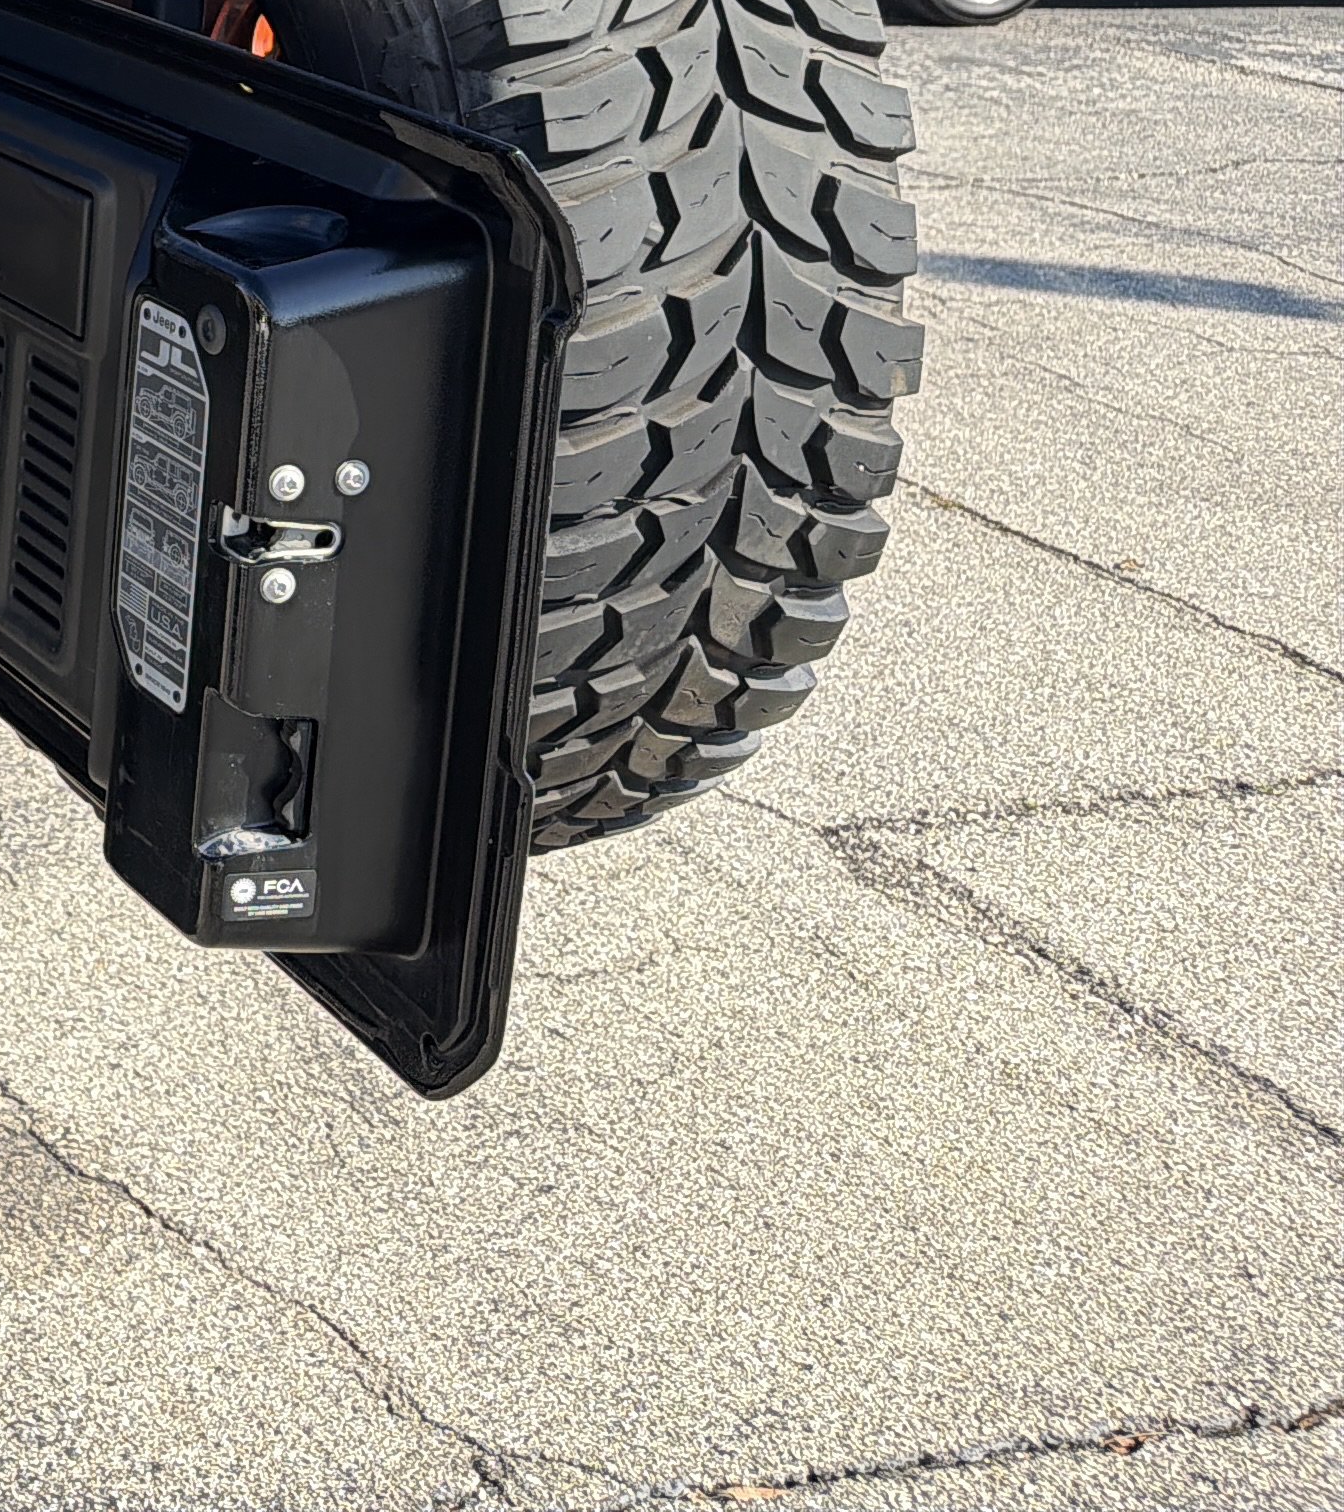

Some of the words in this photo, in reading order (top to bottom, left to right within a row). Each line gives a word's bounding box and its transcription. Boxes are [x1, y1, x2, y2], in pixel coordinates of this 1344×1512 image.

[152, 310, 177, 335] Jeep
[140, 339, 198, 379] JL
[263, 878, 304, 894] FCA
